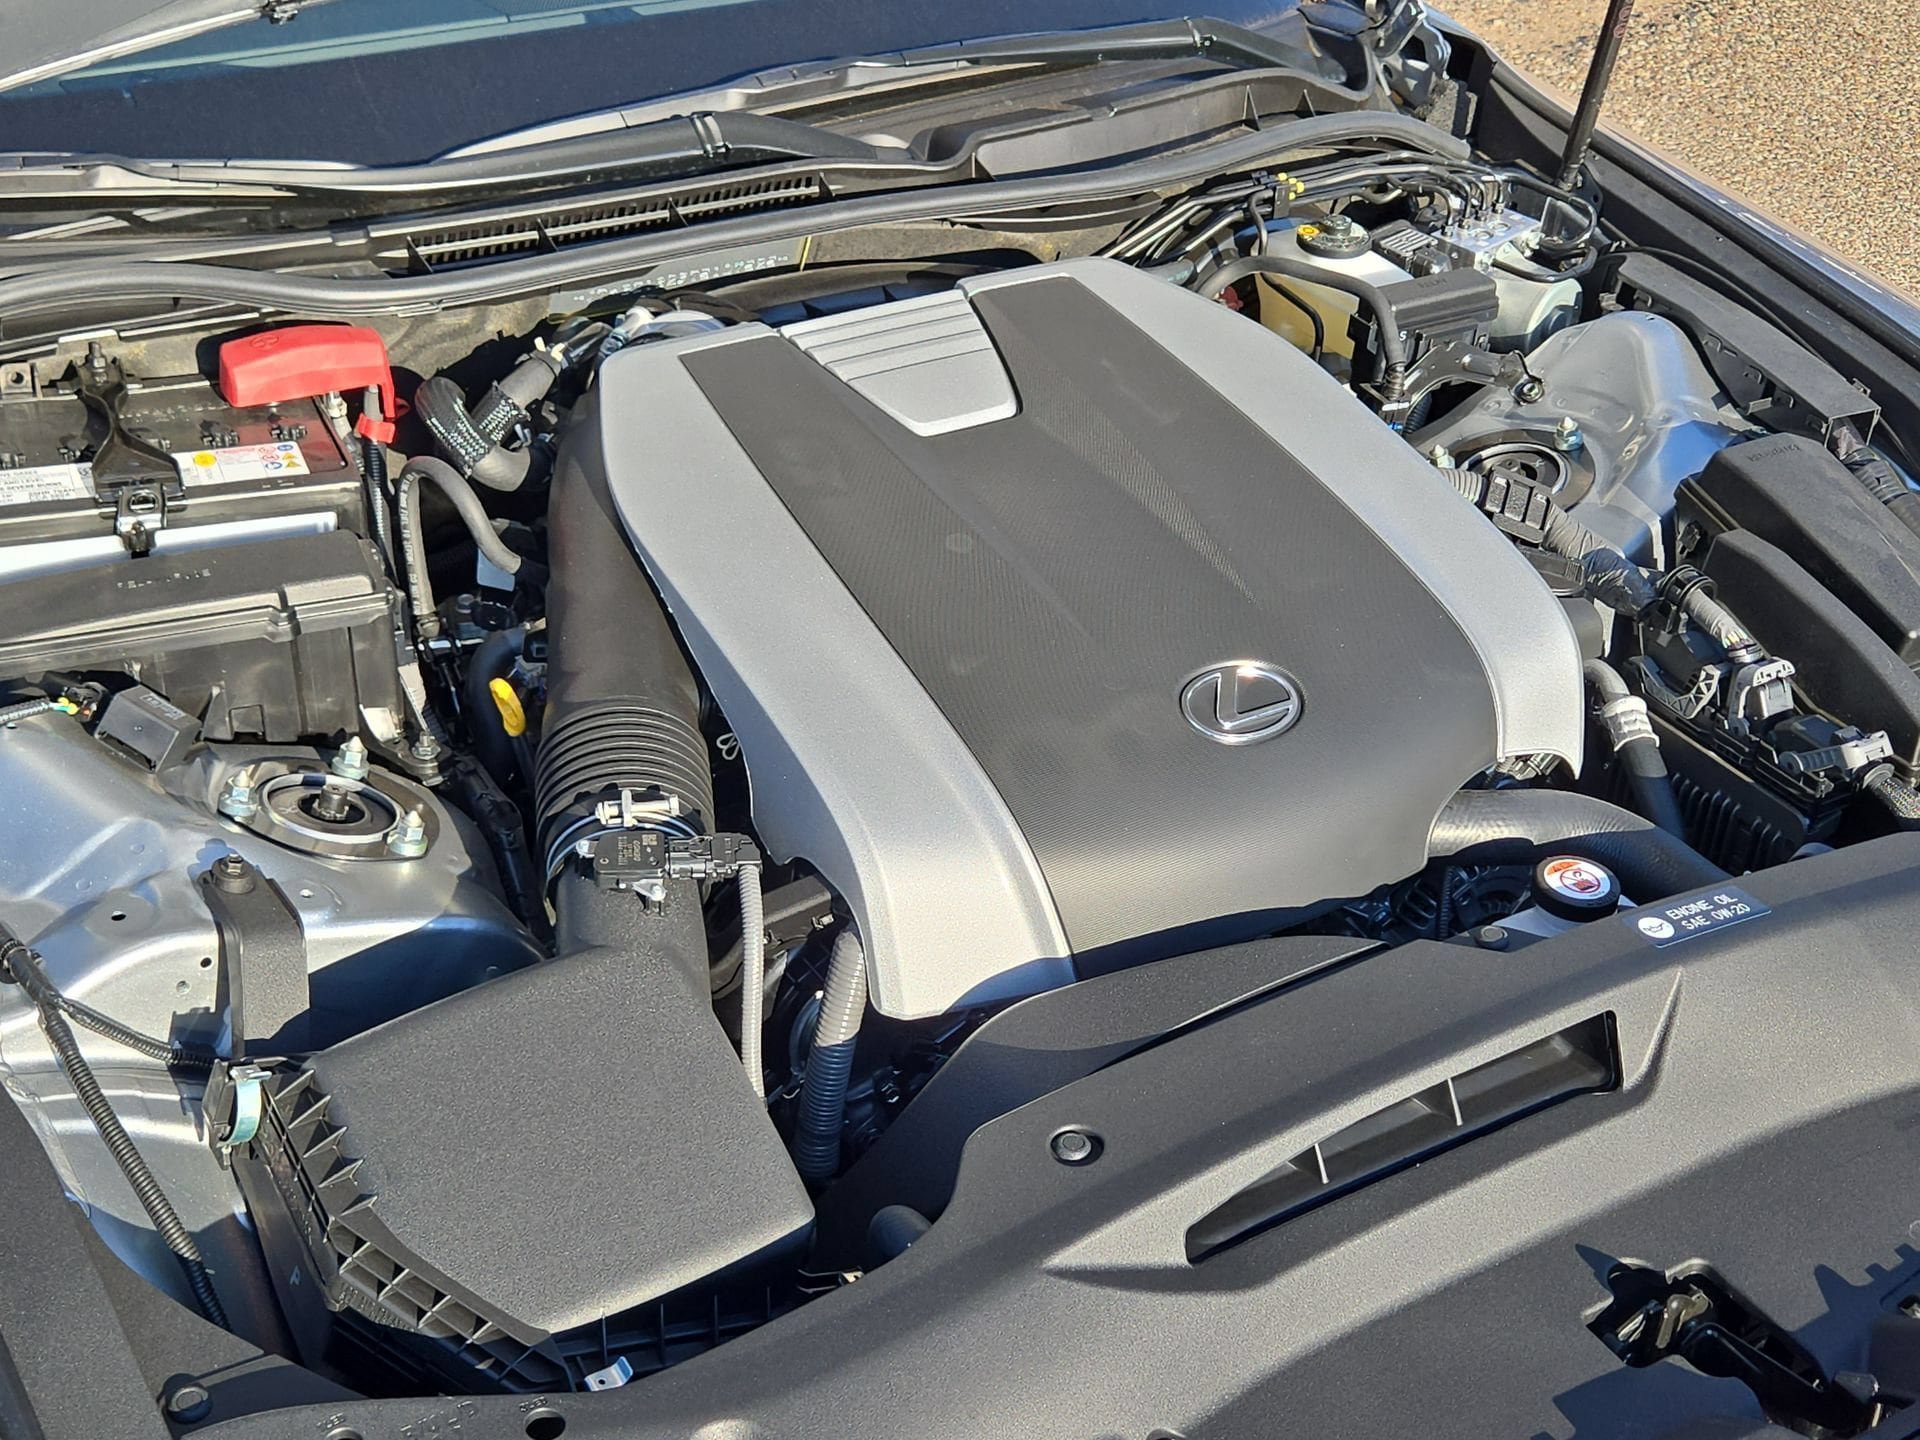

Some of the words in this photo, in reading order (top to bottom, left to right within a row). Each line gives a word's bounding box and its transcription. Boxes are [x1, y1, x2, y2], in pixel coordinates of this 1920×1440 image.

[1665, 899, 1714, 920] ENGINE
[1713, 894, 1739, 905] OIL
[1681, 915, 1711, 930] SAE
[1711, 903, 1751, 920] 0W-20
